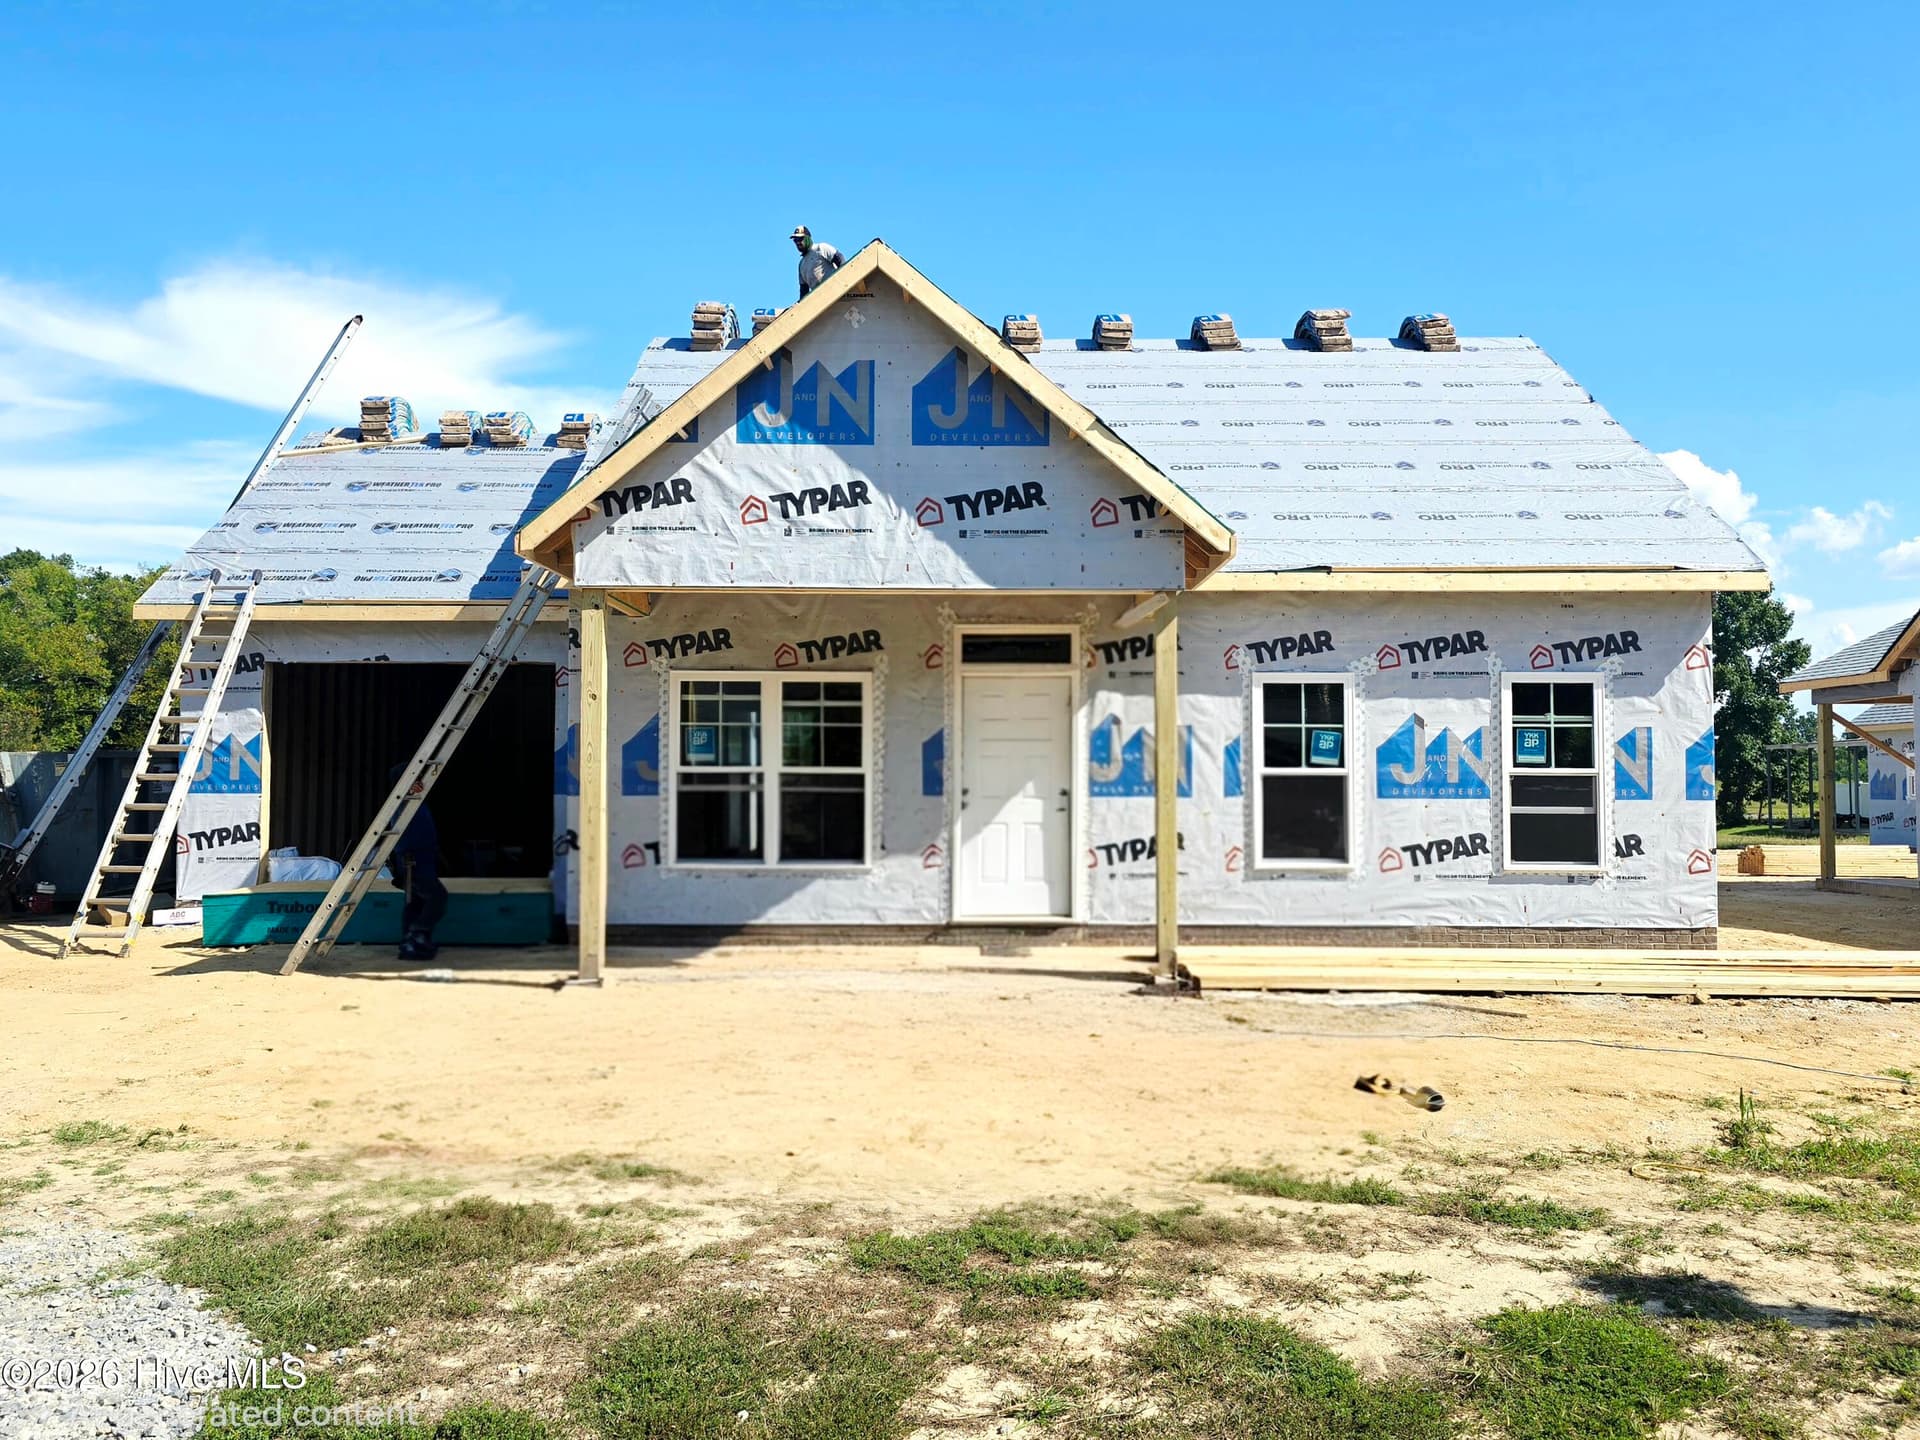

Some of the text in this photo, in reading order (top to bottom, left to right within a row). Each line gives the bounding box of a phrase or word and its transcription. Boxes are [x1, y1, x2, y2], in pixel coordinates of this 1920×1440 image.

[794, 392, 816, 401] AND
[969, 394, 992, 403] AND
[754, 432, 856, 441] DEVELOPERS
[930, 433, 1032, 442] DEVELOPERS
[599, 478, 696, 517] TYPAR
[768, 480, 872, 519] TYPAR
[944, 481, 1048, 521] TYPAR
[645, 628, 734, 660] TYPAR
[796, 629, 884, 662] TYPAR
[1246, 630, 1336, 664] TYPAR
[1398, 630, 1490, 664] TYPAR
[1552, 630, 1642, 664] TYPAR
[1426, 754, 1446, 763] AND
[1392, 788, 1483, 796] DEVELOPERS
[188, 822, 260, 851] TYPAR
[1402, 832, 1490, 867] TYPAR
